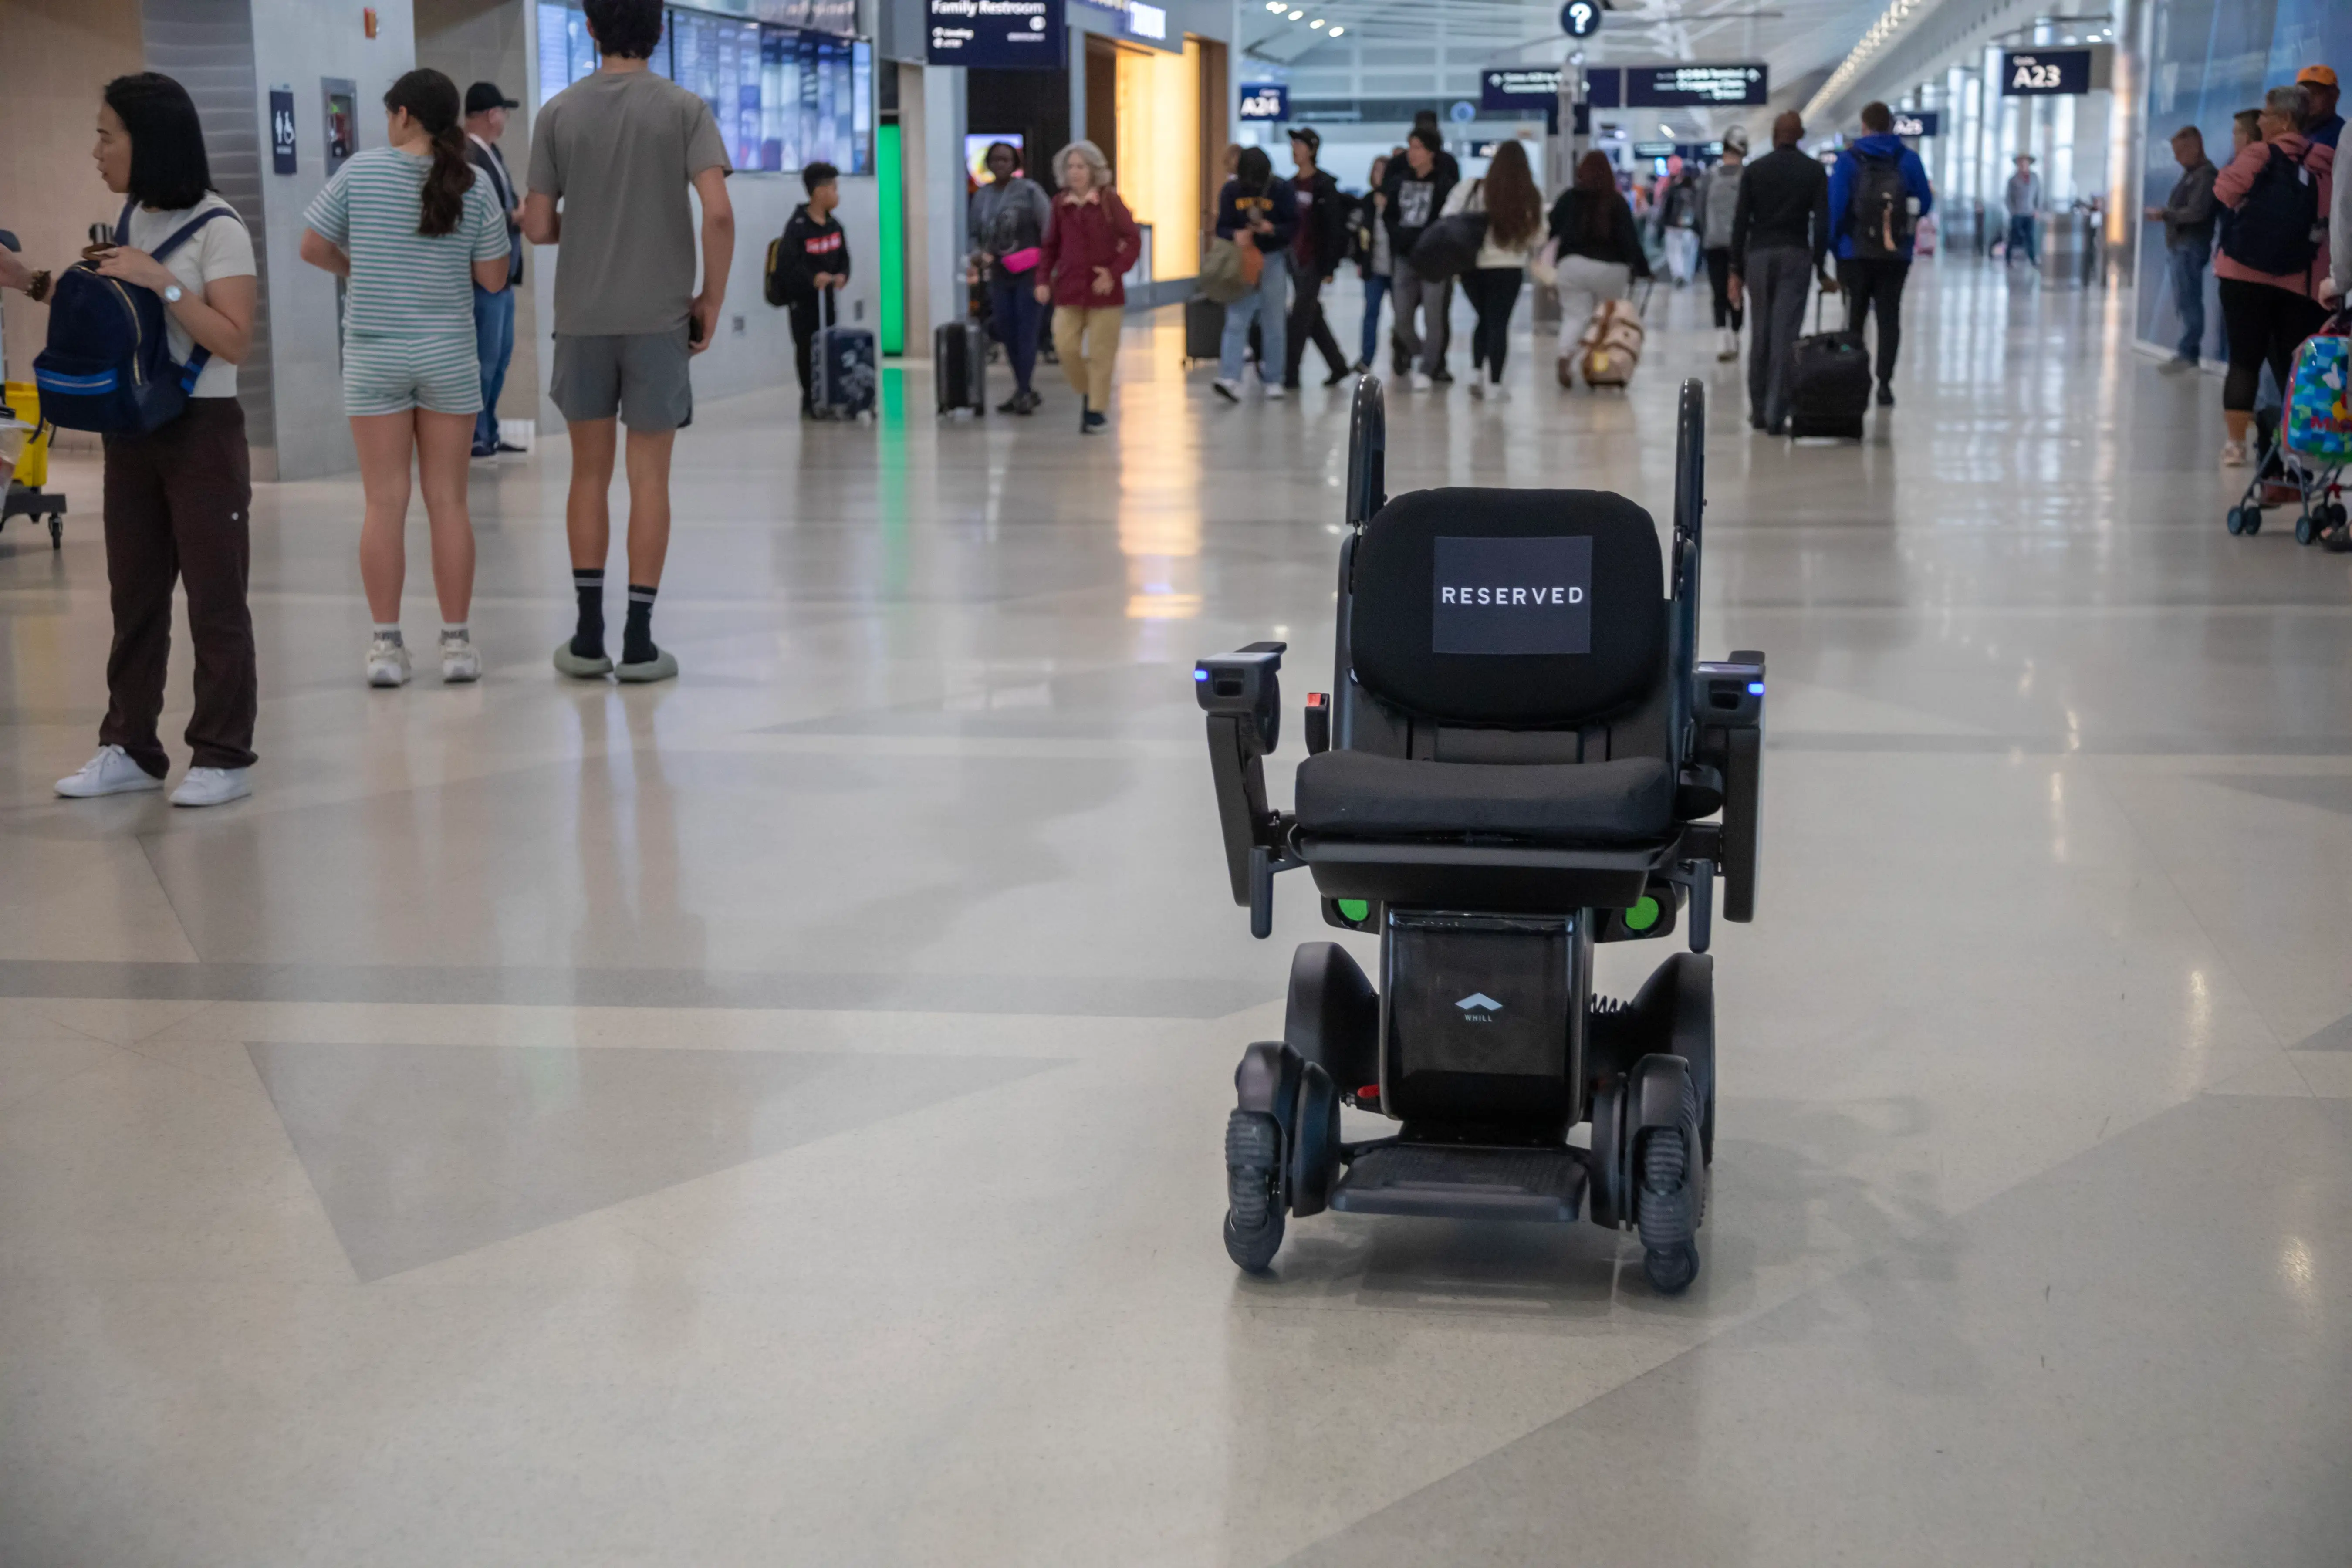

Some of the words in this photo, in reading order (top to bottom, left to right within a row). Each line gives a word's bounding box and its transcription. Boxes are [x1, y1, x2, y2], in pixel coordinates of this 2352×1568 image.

[932, 0, 977, 17] Family
[979, 0, 1045, 15] Restroom
[2012, 65, 2061, 88] A23
[1442, 587, 1583, 605] RESERVED
